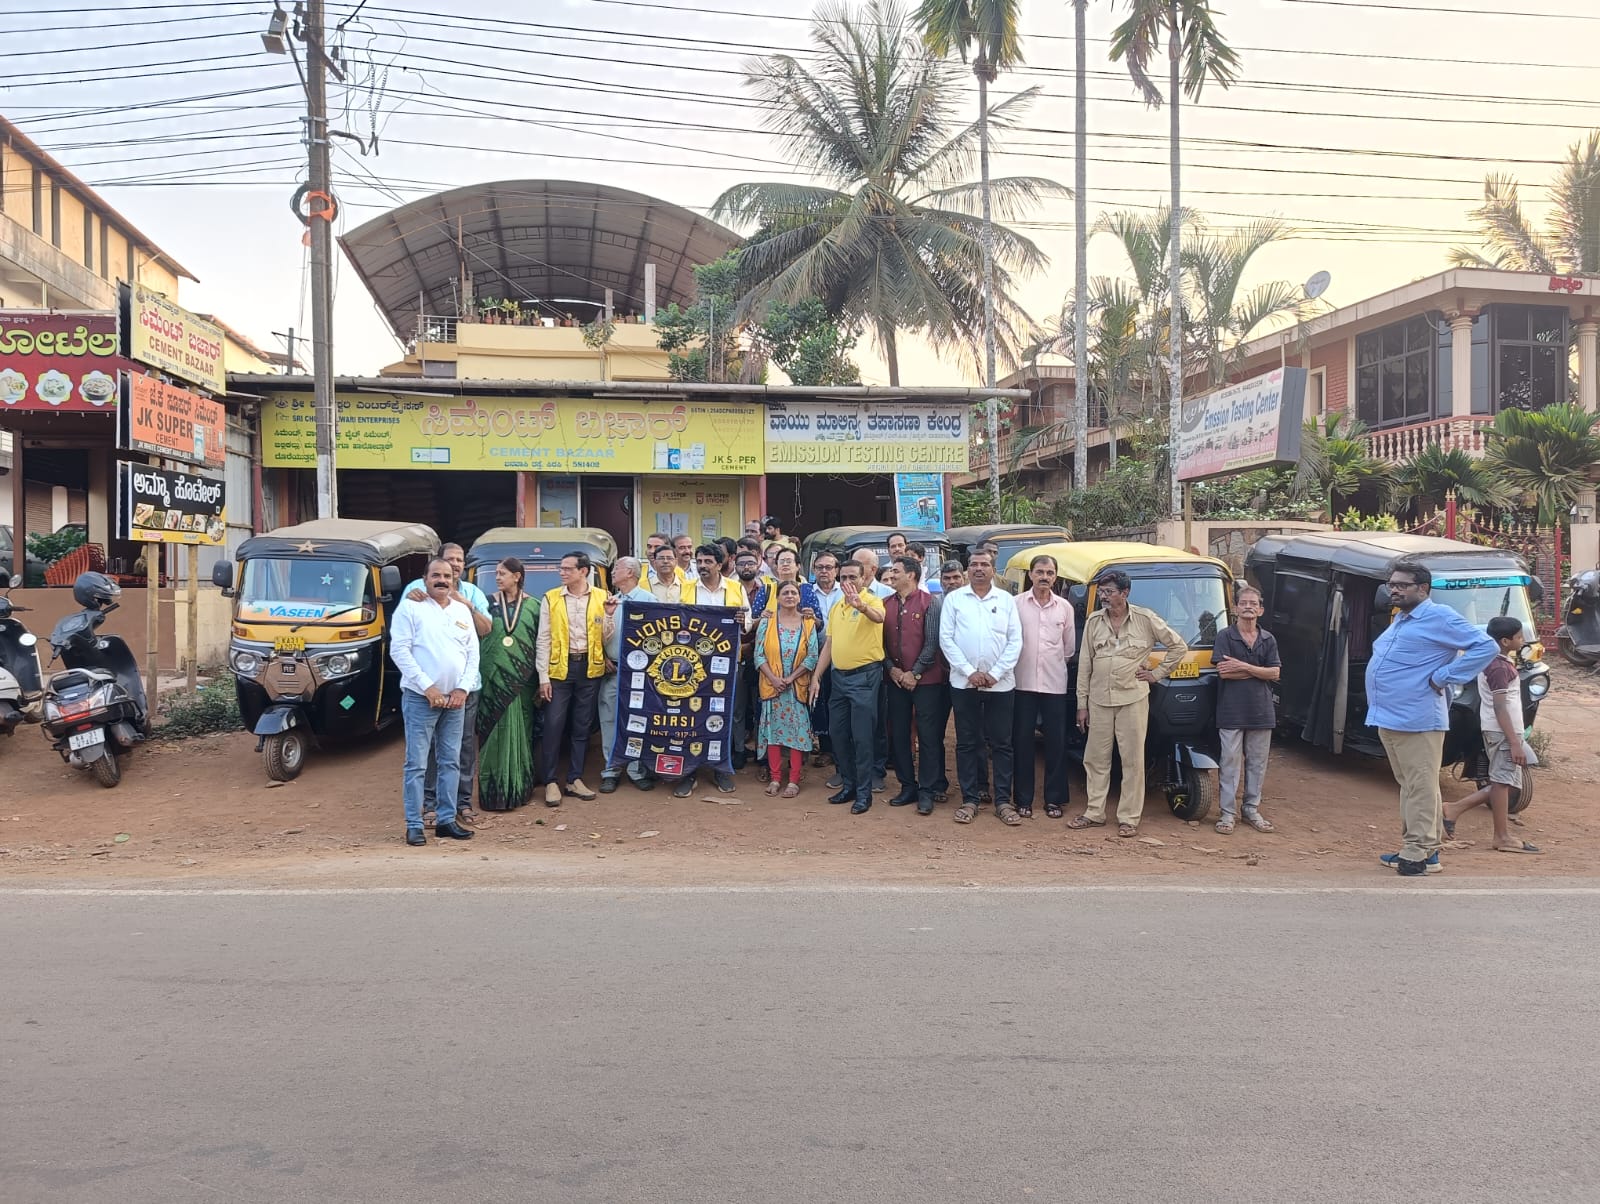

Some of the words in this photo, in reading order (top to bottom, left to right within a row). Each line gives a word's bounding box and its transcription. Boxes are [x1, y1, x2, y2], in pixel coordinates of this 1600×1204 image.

[149, 335, 183, 363] CEMENT
[185, 352, 214, 377] BAZAAR
[1204, 407, 1230, 431] Emission
[1231, 397, 1255, 423] Testing
[1255, 391, 1280, 415] Center
[137, 407, 153, 429] JK
[157, 412, 193, 439] SUPER
[358, 416, 400, 424] ENTERPRISES
[770, 410, 810, 430] ವಾಯು
[867, 410, 921, 431] ತಪಾಸಣಾ
[927, 410, 961, 438] ಕೇಂದ್ರ
[155, 432, 179, 447] CEMENT
[489, 447, 551, 457] CEMENT
[556, 448, 615, 458] BAZAAR
[712, 455, 724, 464] JK
[769, 445, 841, 463] EMISSION
[844, 445, 904, 463] TESTING
[910, 445, 964, 463] CENTRE
[269, 605, 326, 618] YASEEN
[627, 615, 682, 648] LIONS
[688, 618, 732, 653] CLUB
[663, 647, 697, 661] LIONS
[671, 662, 687, 682] L
[653, 714, 695, 728] SIRSI
